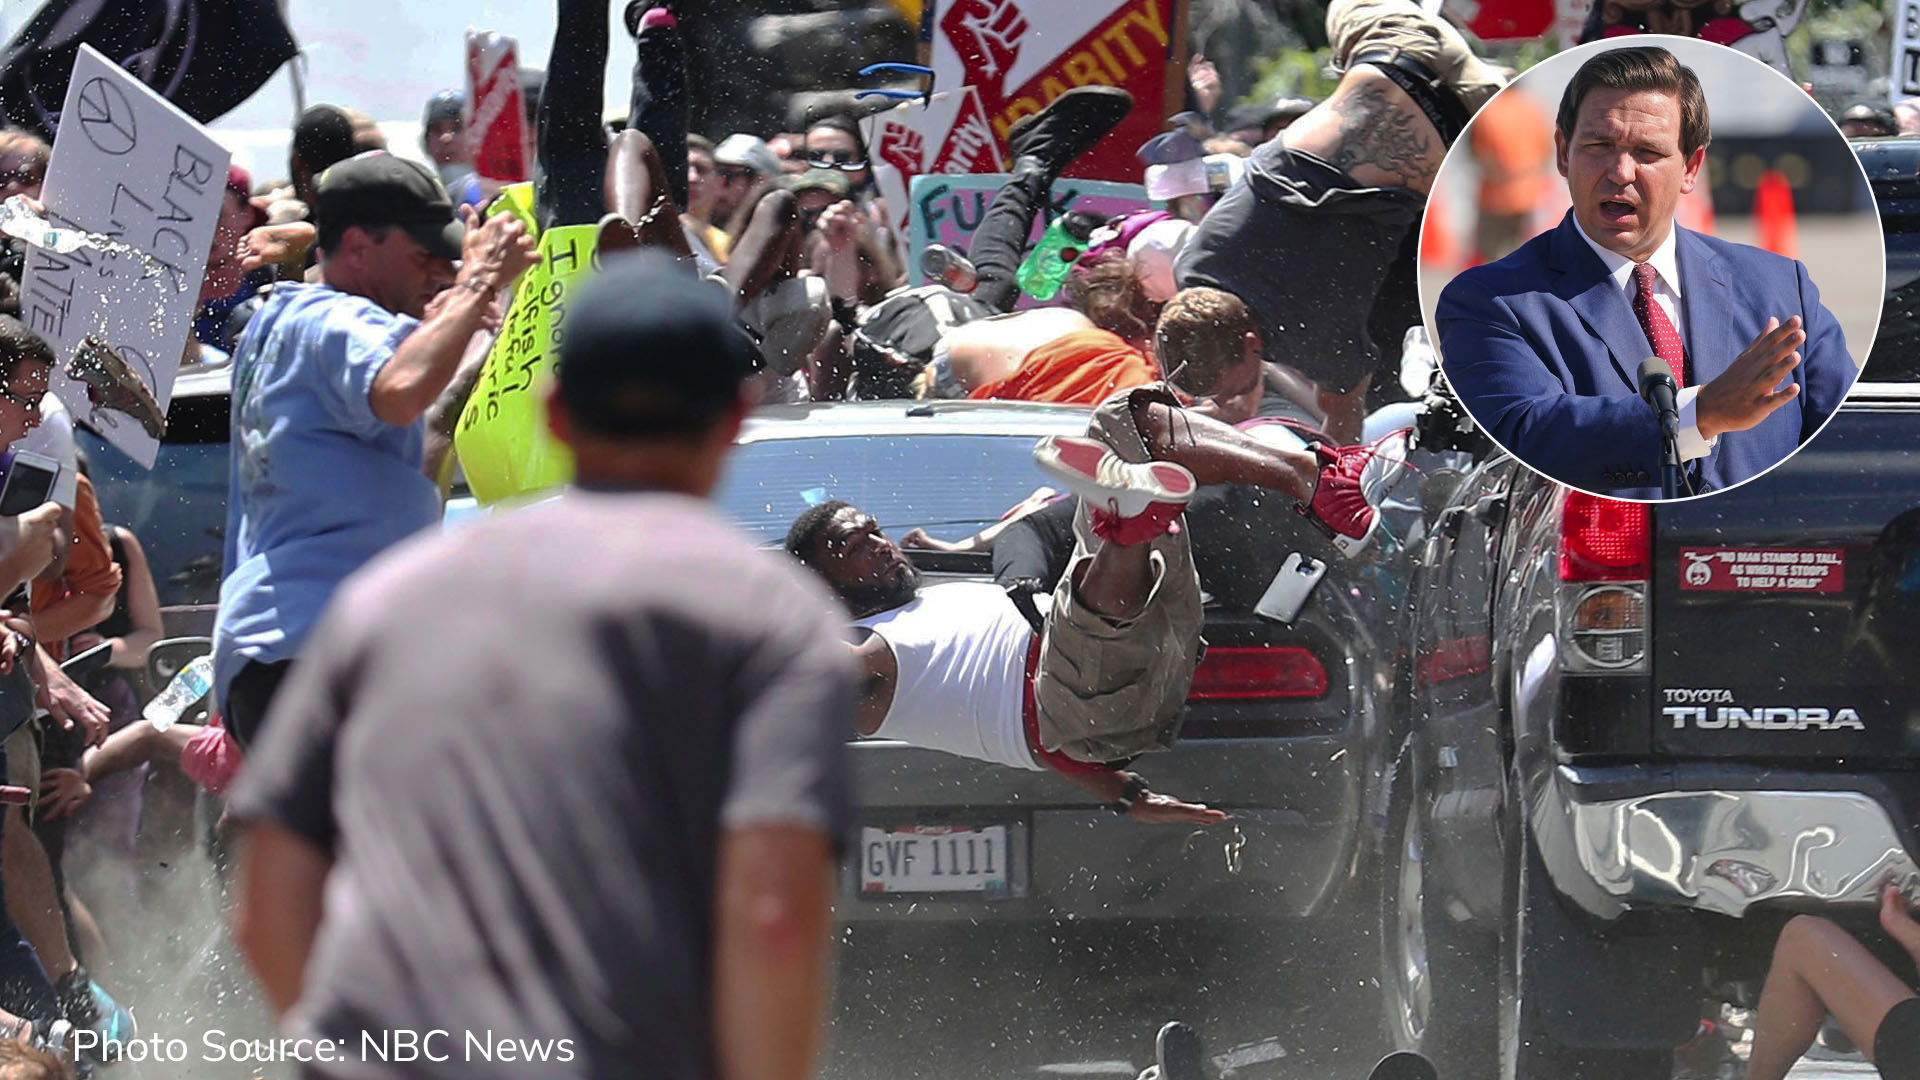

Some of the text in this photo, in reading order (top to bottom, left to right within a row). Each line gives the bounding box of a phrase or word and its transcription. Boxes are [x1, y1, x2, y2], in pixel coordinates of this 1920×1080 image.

[944, 114, 991, 174] arity
[140, 144, 212, 294] BLACK
[919, 183, 1078, 240] FUK
[30, 210, 93, 338] MATTE
[521, 272, 542, 391] elfish
[1729, 564, 1829, 577] AS WHEN HE STOOPS
[1737, 552, 1761, 563] MAN
[1762, 552, 1800, 564] STANDS
[1800, 553, 1815, 564] SO
[1736, 577, 1751, 588] TO
[1751, 577, 1777, 588] HELP
[1777, 578, 1786, 588] A
[1663, 688, 1735, 703] TOYOTA
[1662, 706, 1866, 731] TUNDRA
[868, 838, 996, 877] GVF 1111
